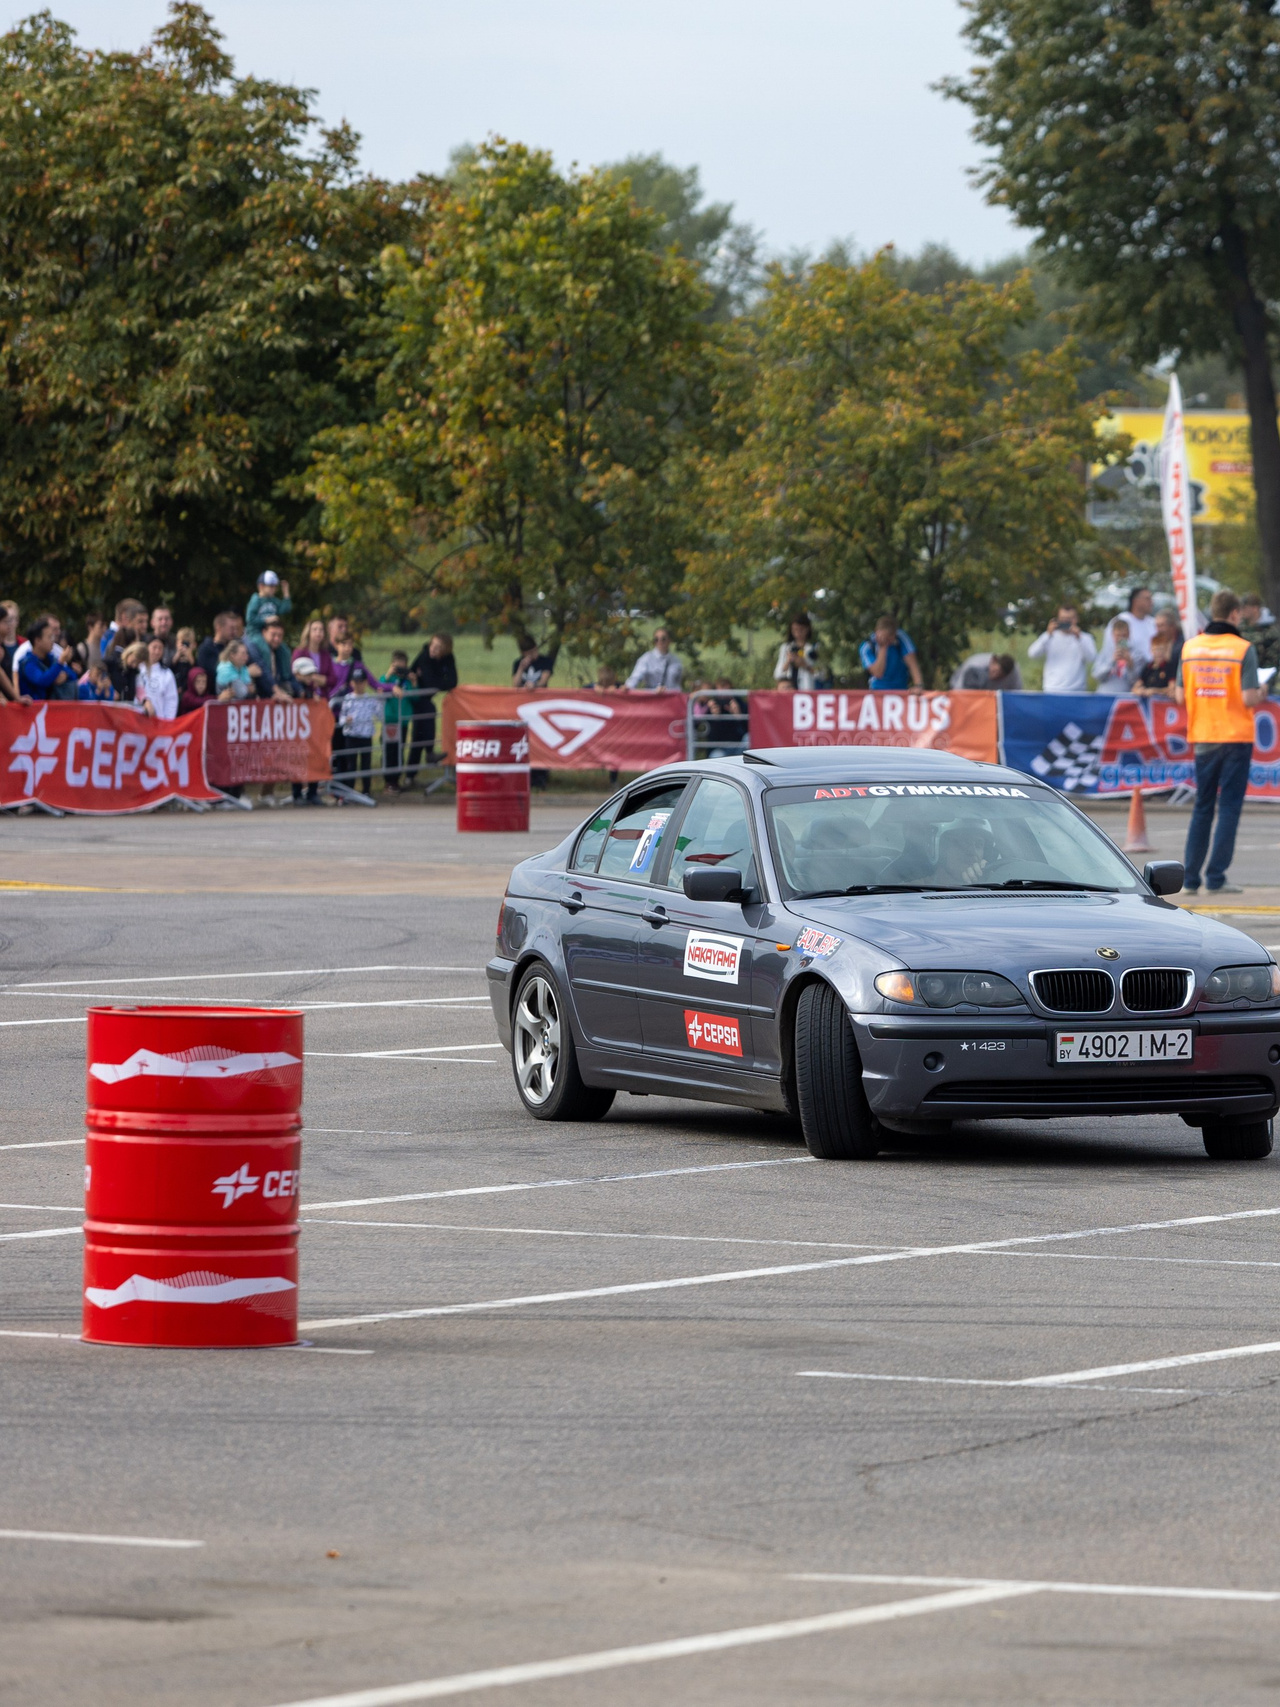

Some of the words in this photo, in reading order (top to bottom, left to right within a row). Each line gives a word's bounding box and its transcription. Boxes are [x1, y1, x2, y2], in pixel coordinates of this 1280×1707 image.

[227, 703, 311, 742] BELARUS
[793, 693, 951, 732] BELARUS
[65, 727, 193, 790] CEPSA
[815, 785, 1030, 799] ADTGYMKHANA
[687, 945, 737, 968] NAKAYAMA
[703, 1022, 739, 1047] CEPSA
[971, 1041, 1006, 1051] 1423
[1059, 1049, 1072, 1060] BY
[1078, 1034, 1130, 1059] 4902
